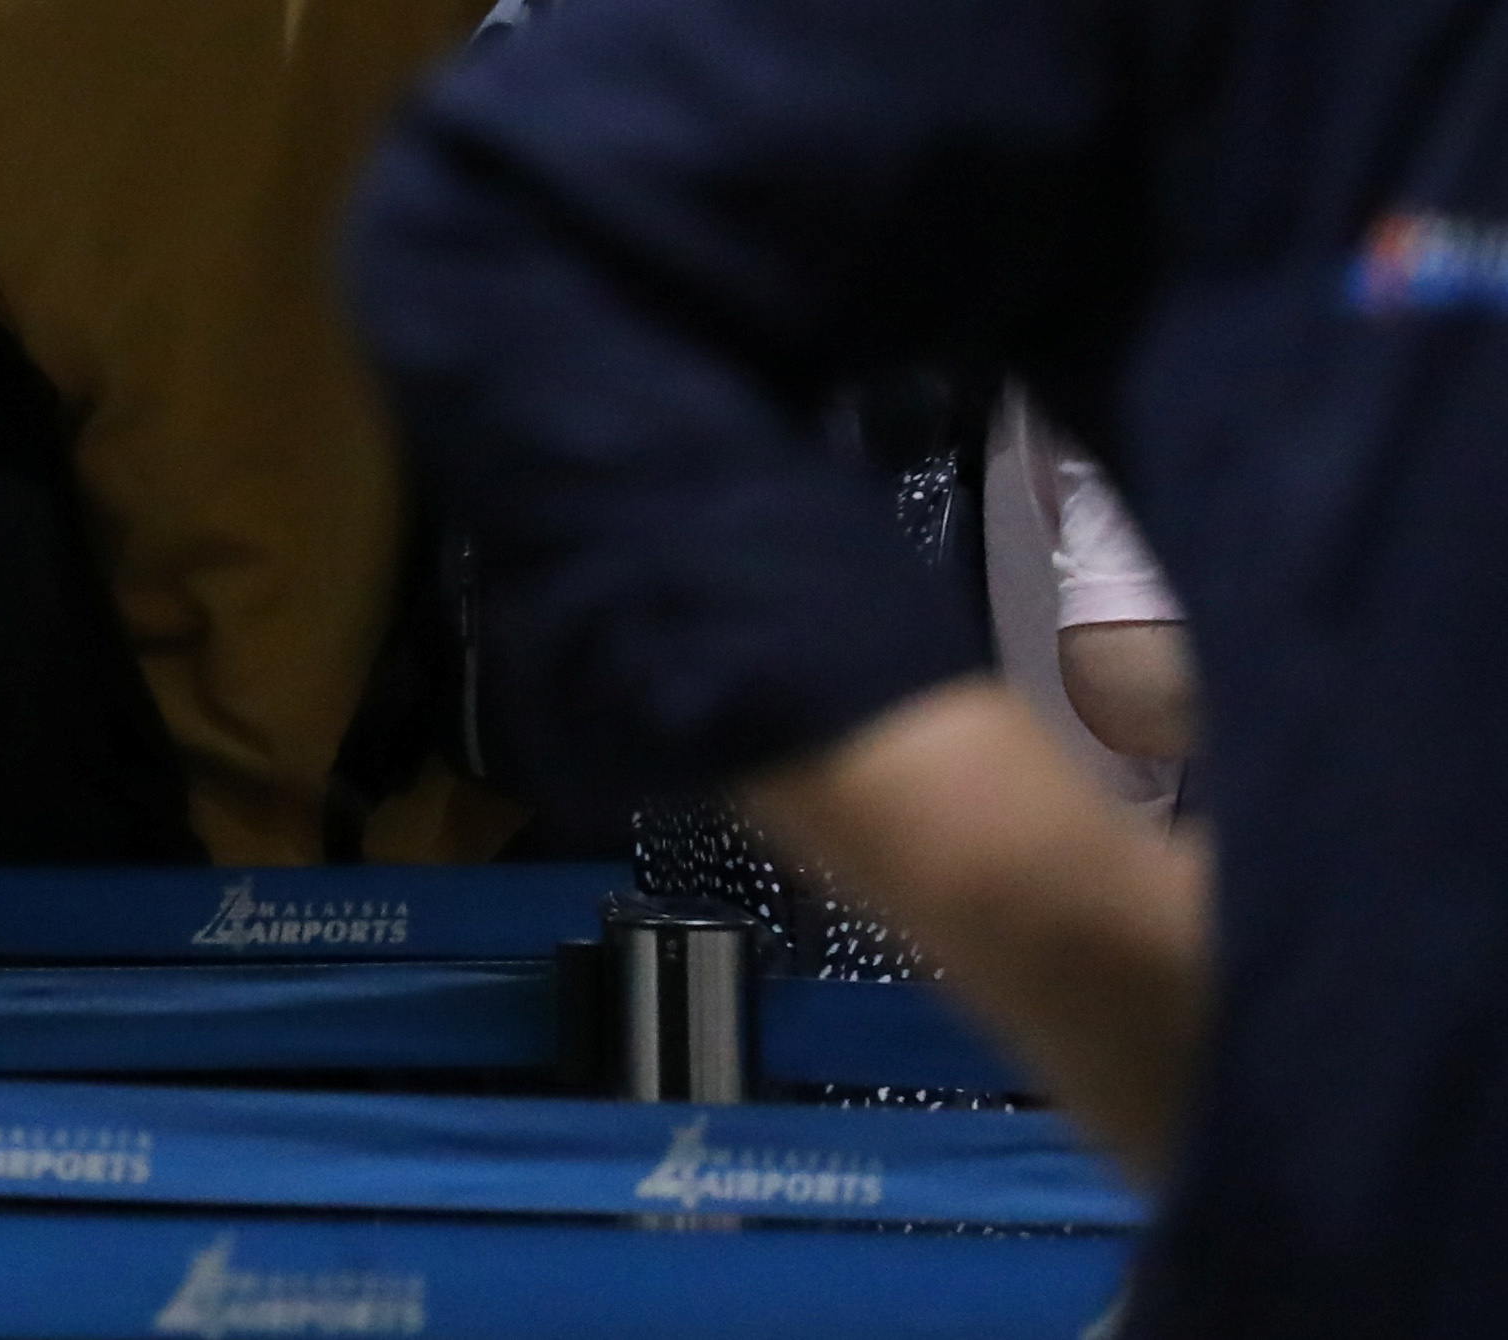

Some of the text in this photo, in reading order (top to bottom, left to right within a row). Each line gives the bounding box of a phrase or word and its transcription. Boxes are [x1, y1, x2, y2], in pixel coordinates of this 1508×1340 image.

[257, 901, 408, 919] MALAYSIA
[248, 919, 408, 945] AIRPORTS
[701, 1170, 883, 1204] AIRPORTS
